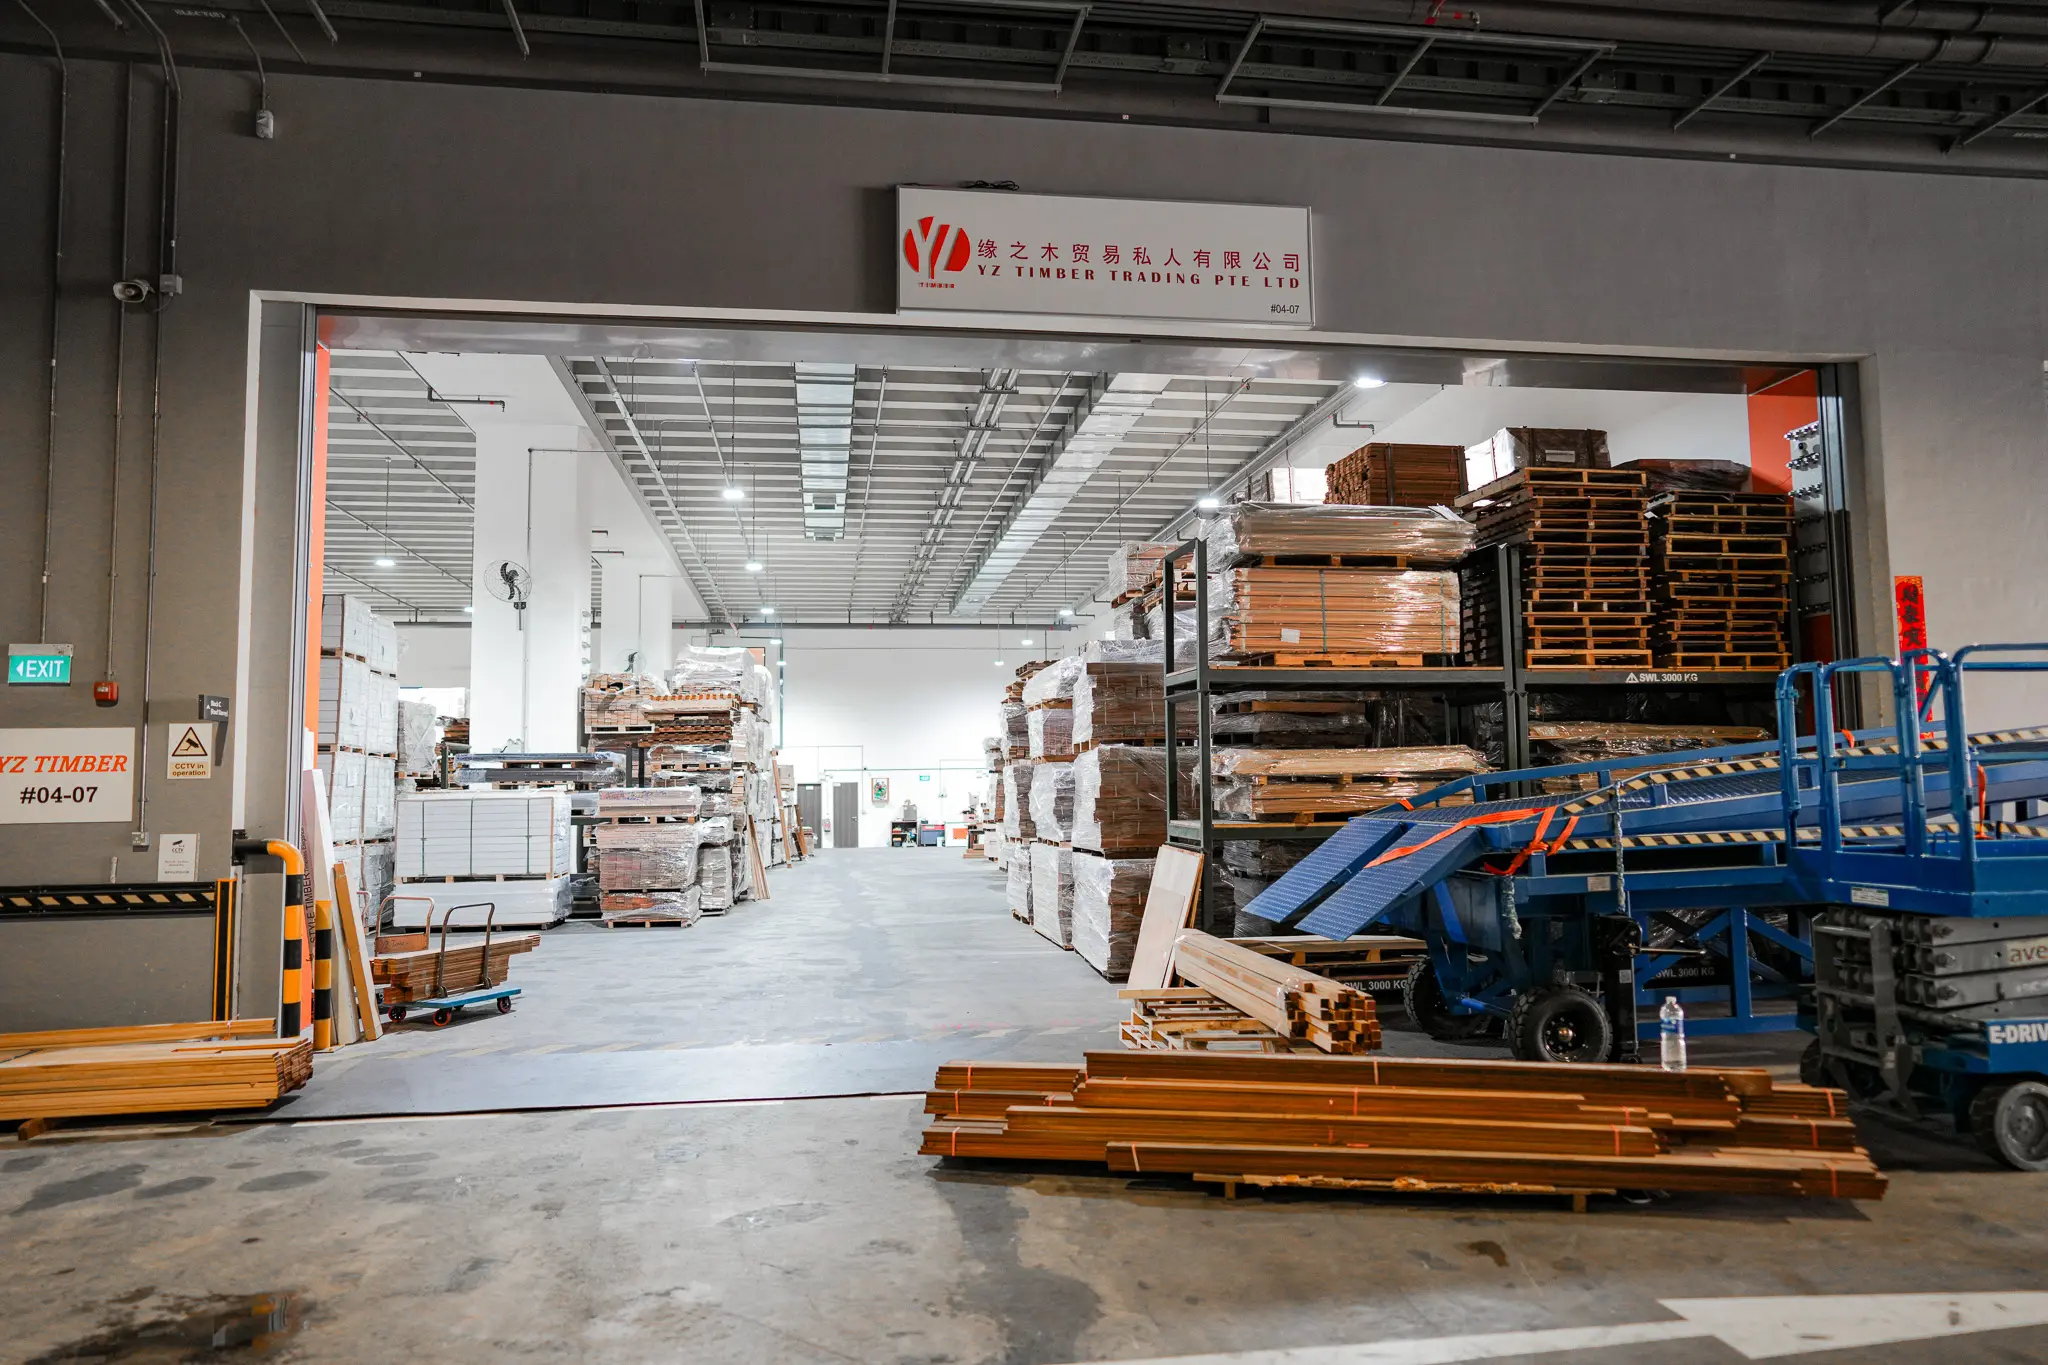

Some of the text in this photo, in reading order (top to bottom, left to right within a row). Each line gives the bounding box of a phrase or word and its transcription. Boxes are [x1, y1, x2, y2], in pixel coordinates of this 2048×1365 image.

[977, 239, 1300, 273] 缘之木贸易私人有限公司
[977, 264, 1300, 289] YZ TIMBER TRADING PTE LTD
[1270, 304, 1300, 314] #04-07
[26, 659, 65, 678] EXIT
[1639, 673, 1698, 682] SWL 3000 KG
[0, 754, 129, 774] YZ TIMBER
[172, 770, 206, 778] operation
[19, 786, 98, 804] #04-07
[303, 873, 313, 910] TIMBER
[1678, 967, 1699, 977] 3000
[1701, 967, 1715, 976] KG
[1368, 980, 1391, 990] 3000
